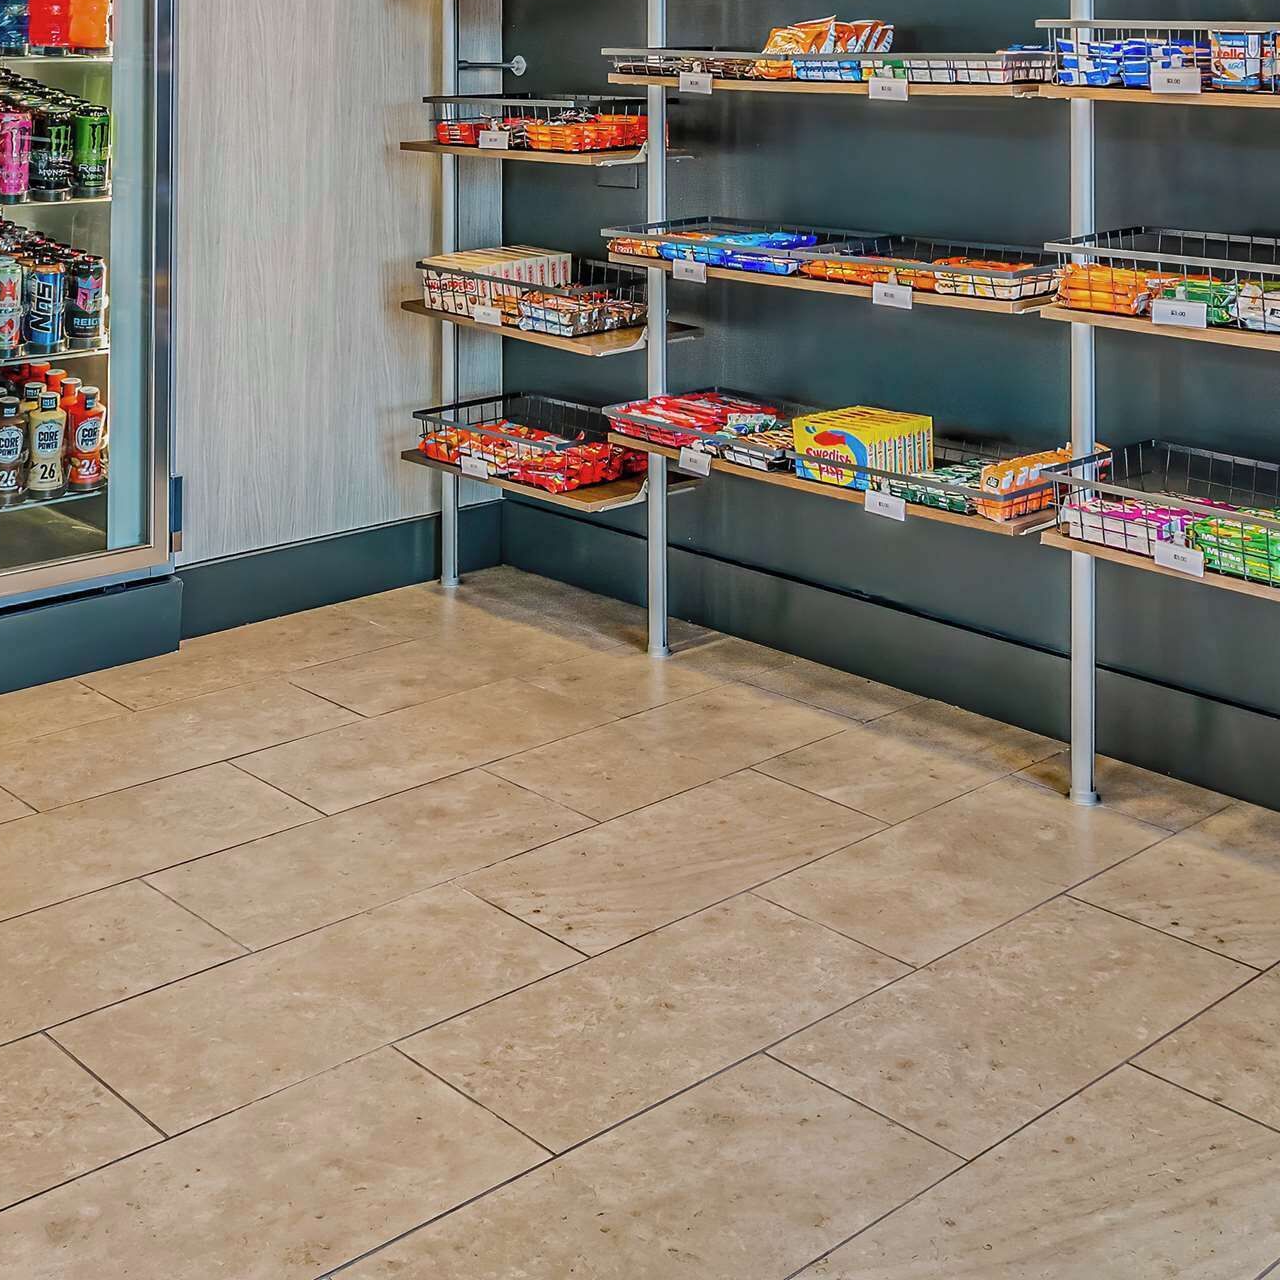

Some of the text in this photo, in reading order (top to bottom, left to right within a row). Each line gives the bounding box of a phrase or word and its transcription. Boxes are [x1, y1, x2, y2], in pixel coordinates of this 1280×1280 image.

[1212, 49, 1245, 60] utella
[73, 317, 101, 326] REIG
[38, 431, 60, 443] CORE
[38, 441, 59, 450] POWER
[40, 463, 57, 480] 26
[80, 459, 97, 474] 26
